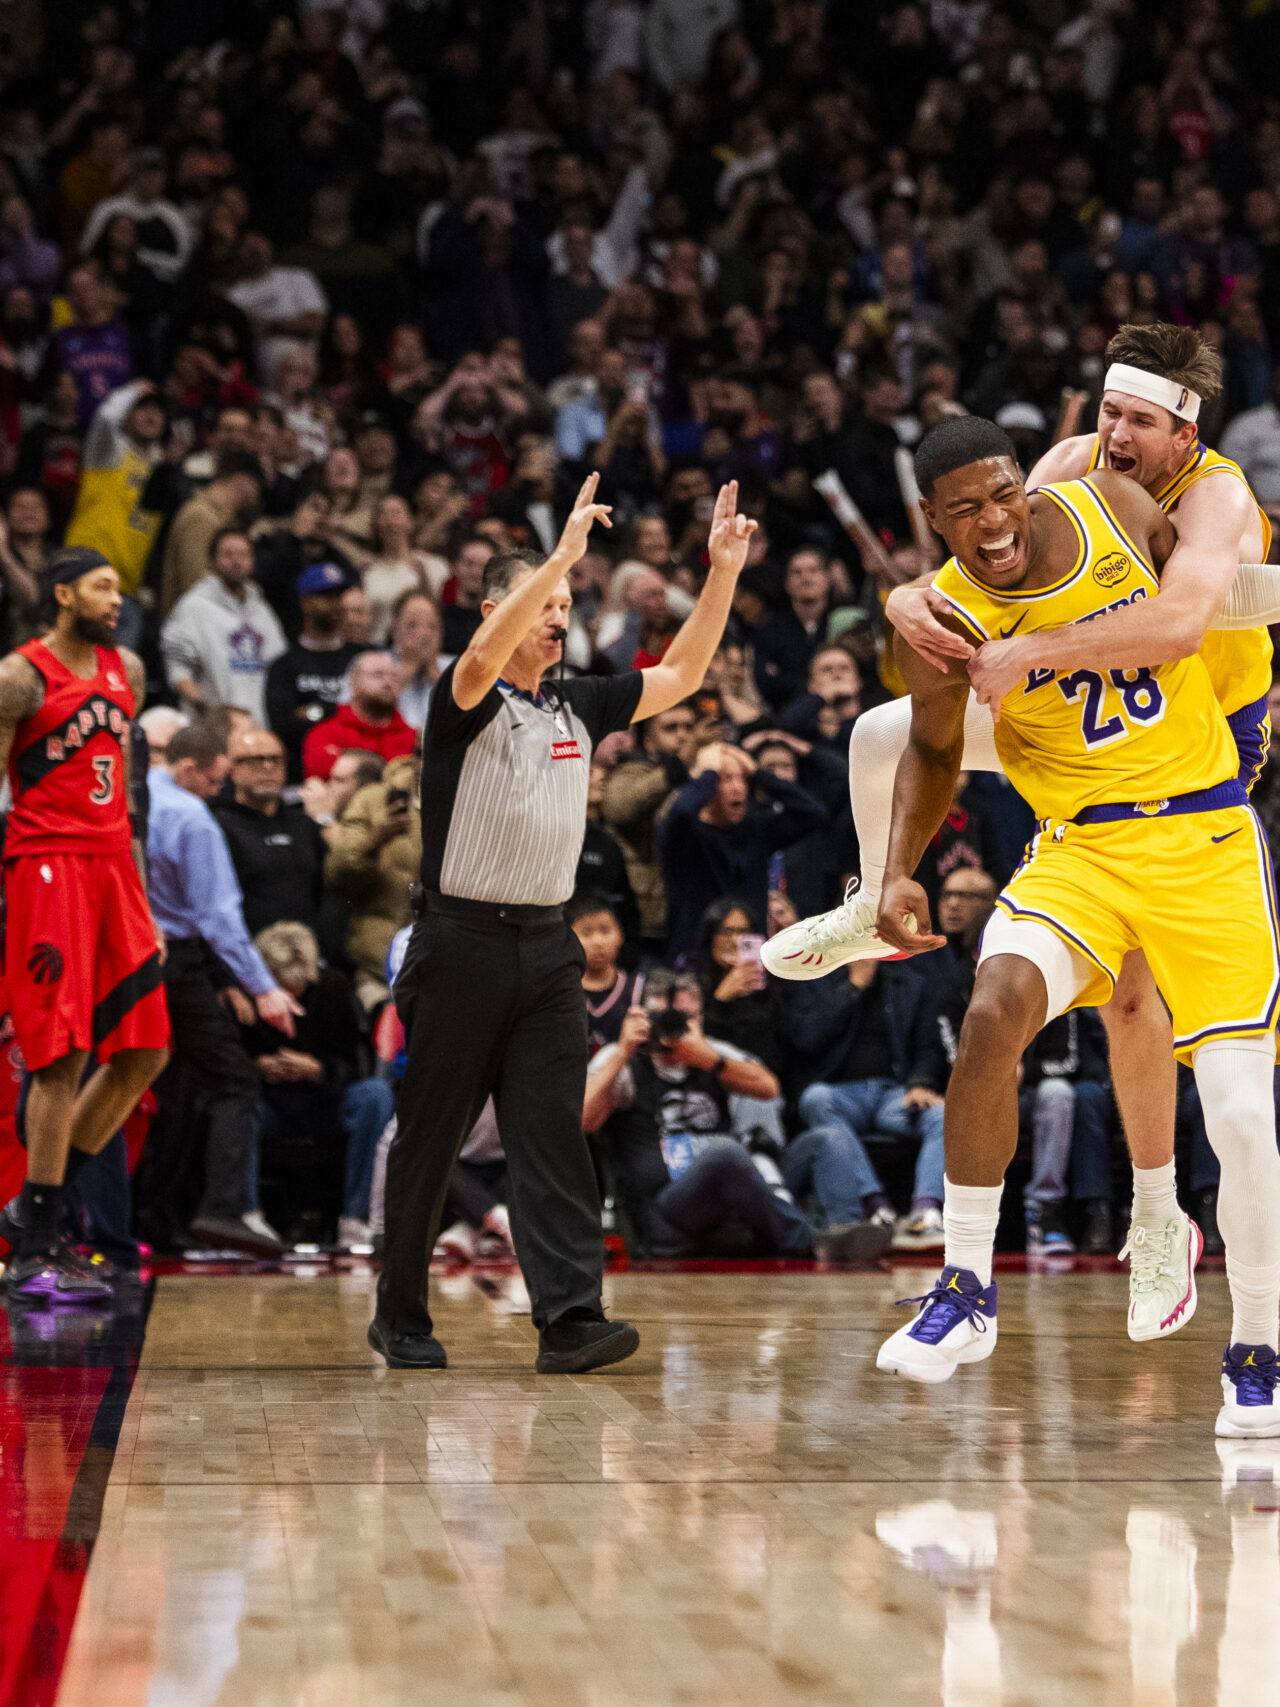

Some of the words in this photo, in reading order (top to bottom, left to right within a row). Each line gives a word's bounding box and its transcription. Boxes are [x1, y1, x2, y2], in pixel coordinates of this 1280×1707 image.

[1095, 557, 1127, 580] bibigo
[1056, 668, 1167, 751] 28
[89, 755, 114, 805] 3
